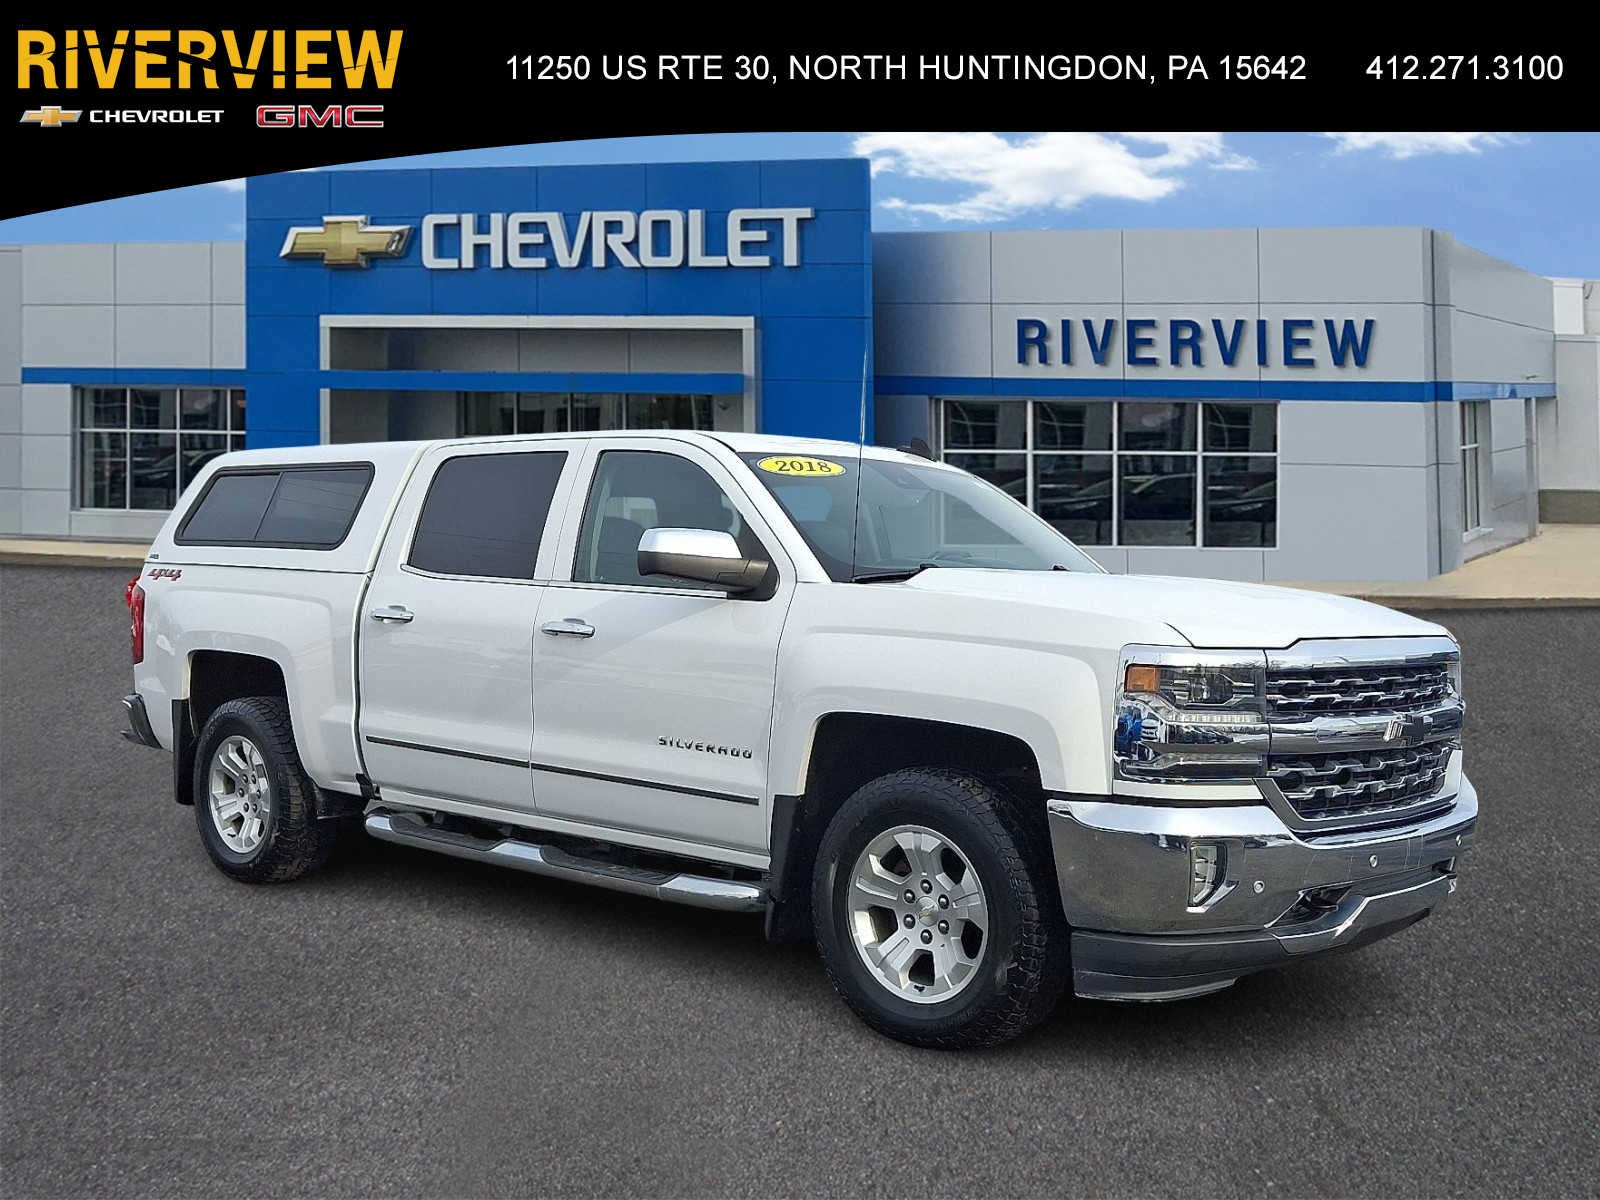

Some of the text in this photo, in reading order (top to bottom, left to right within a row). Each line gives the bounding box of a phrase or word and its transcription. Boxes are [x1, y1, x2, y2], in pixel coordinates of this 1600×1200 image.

[421, 207, 814, 269] CHEVROLET
[1016, 318, 1376, 367] RIVERVIEW
[775, 460, 832, 473] 2018
[658, 735, 754, 760] SILVERADO
